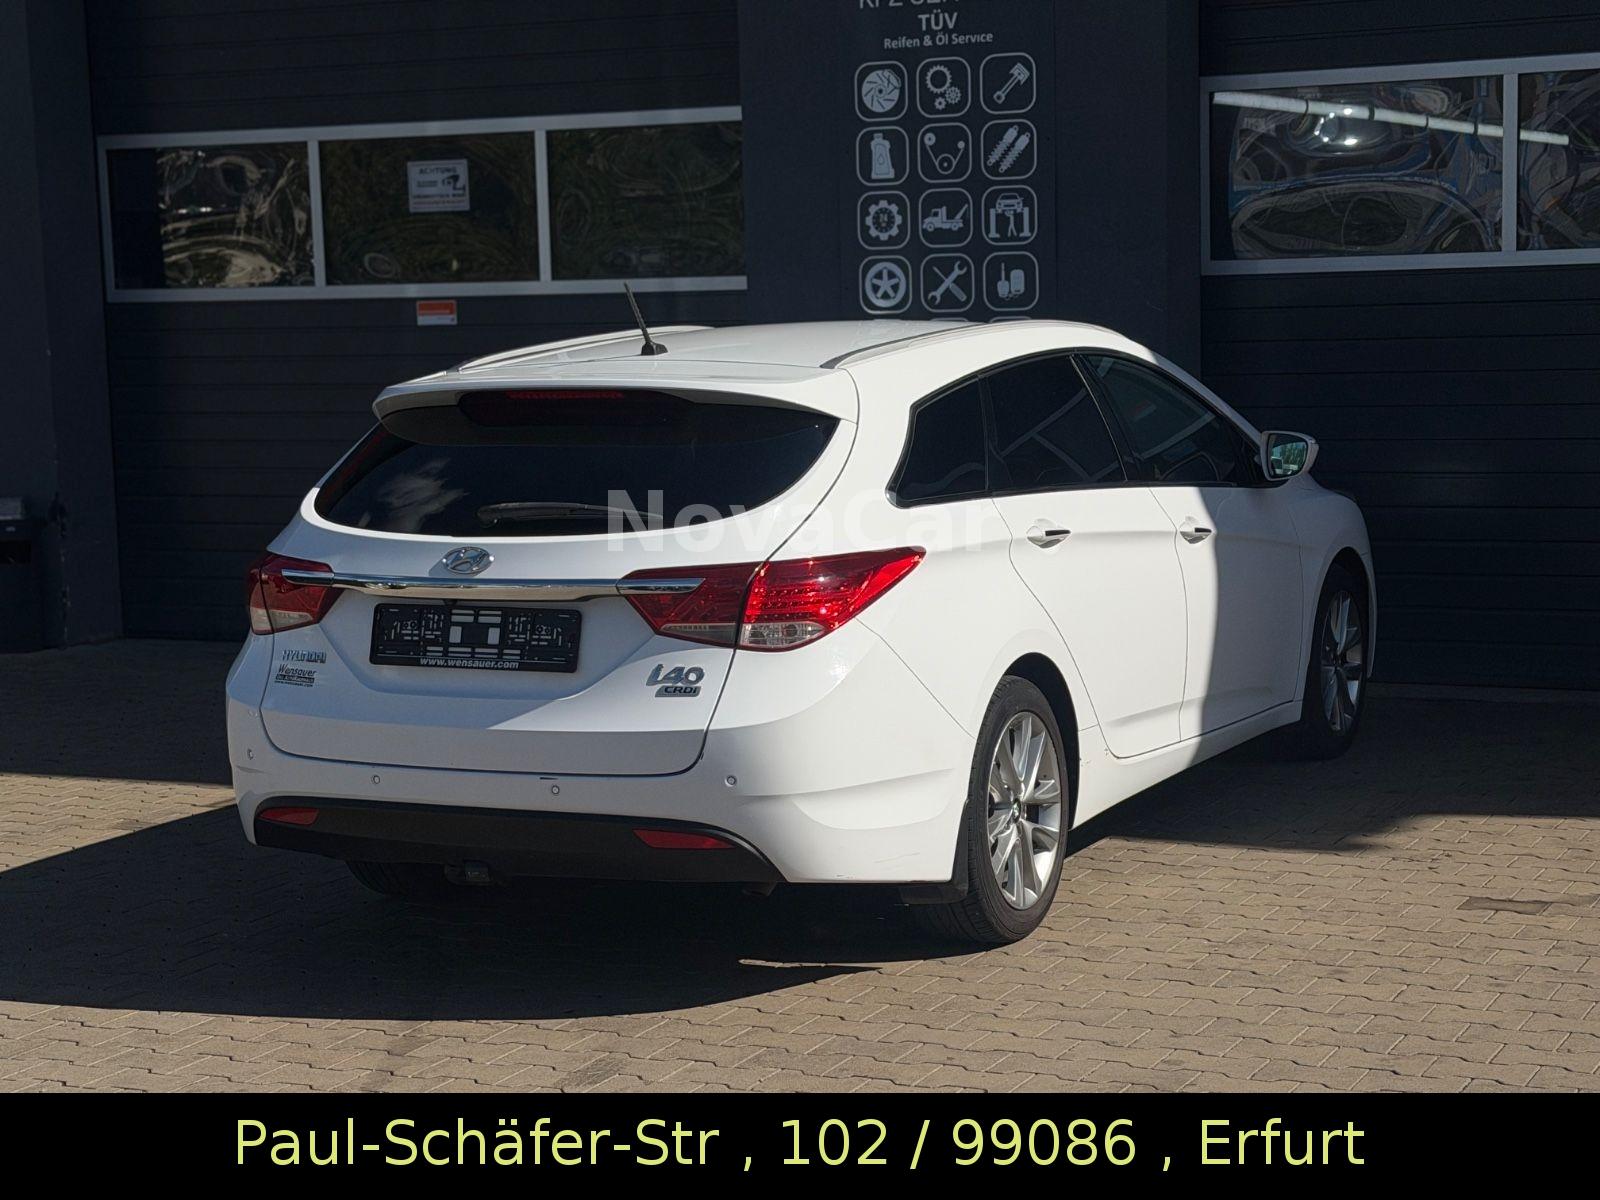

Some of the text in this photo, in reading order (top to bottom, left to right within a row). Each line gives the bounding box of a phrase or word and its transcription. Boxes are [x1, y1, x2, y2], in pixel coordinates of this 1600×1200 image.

[917, 9, 958, 31] TÜV
[884, 32, 993, 49] Reifen & Öl Service
[278, 663, 317, 677] Wensauer
[420, 657, 519, 669] www.wensauer.com
